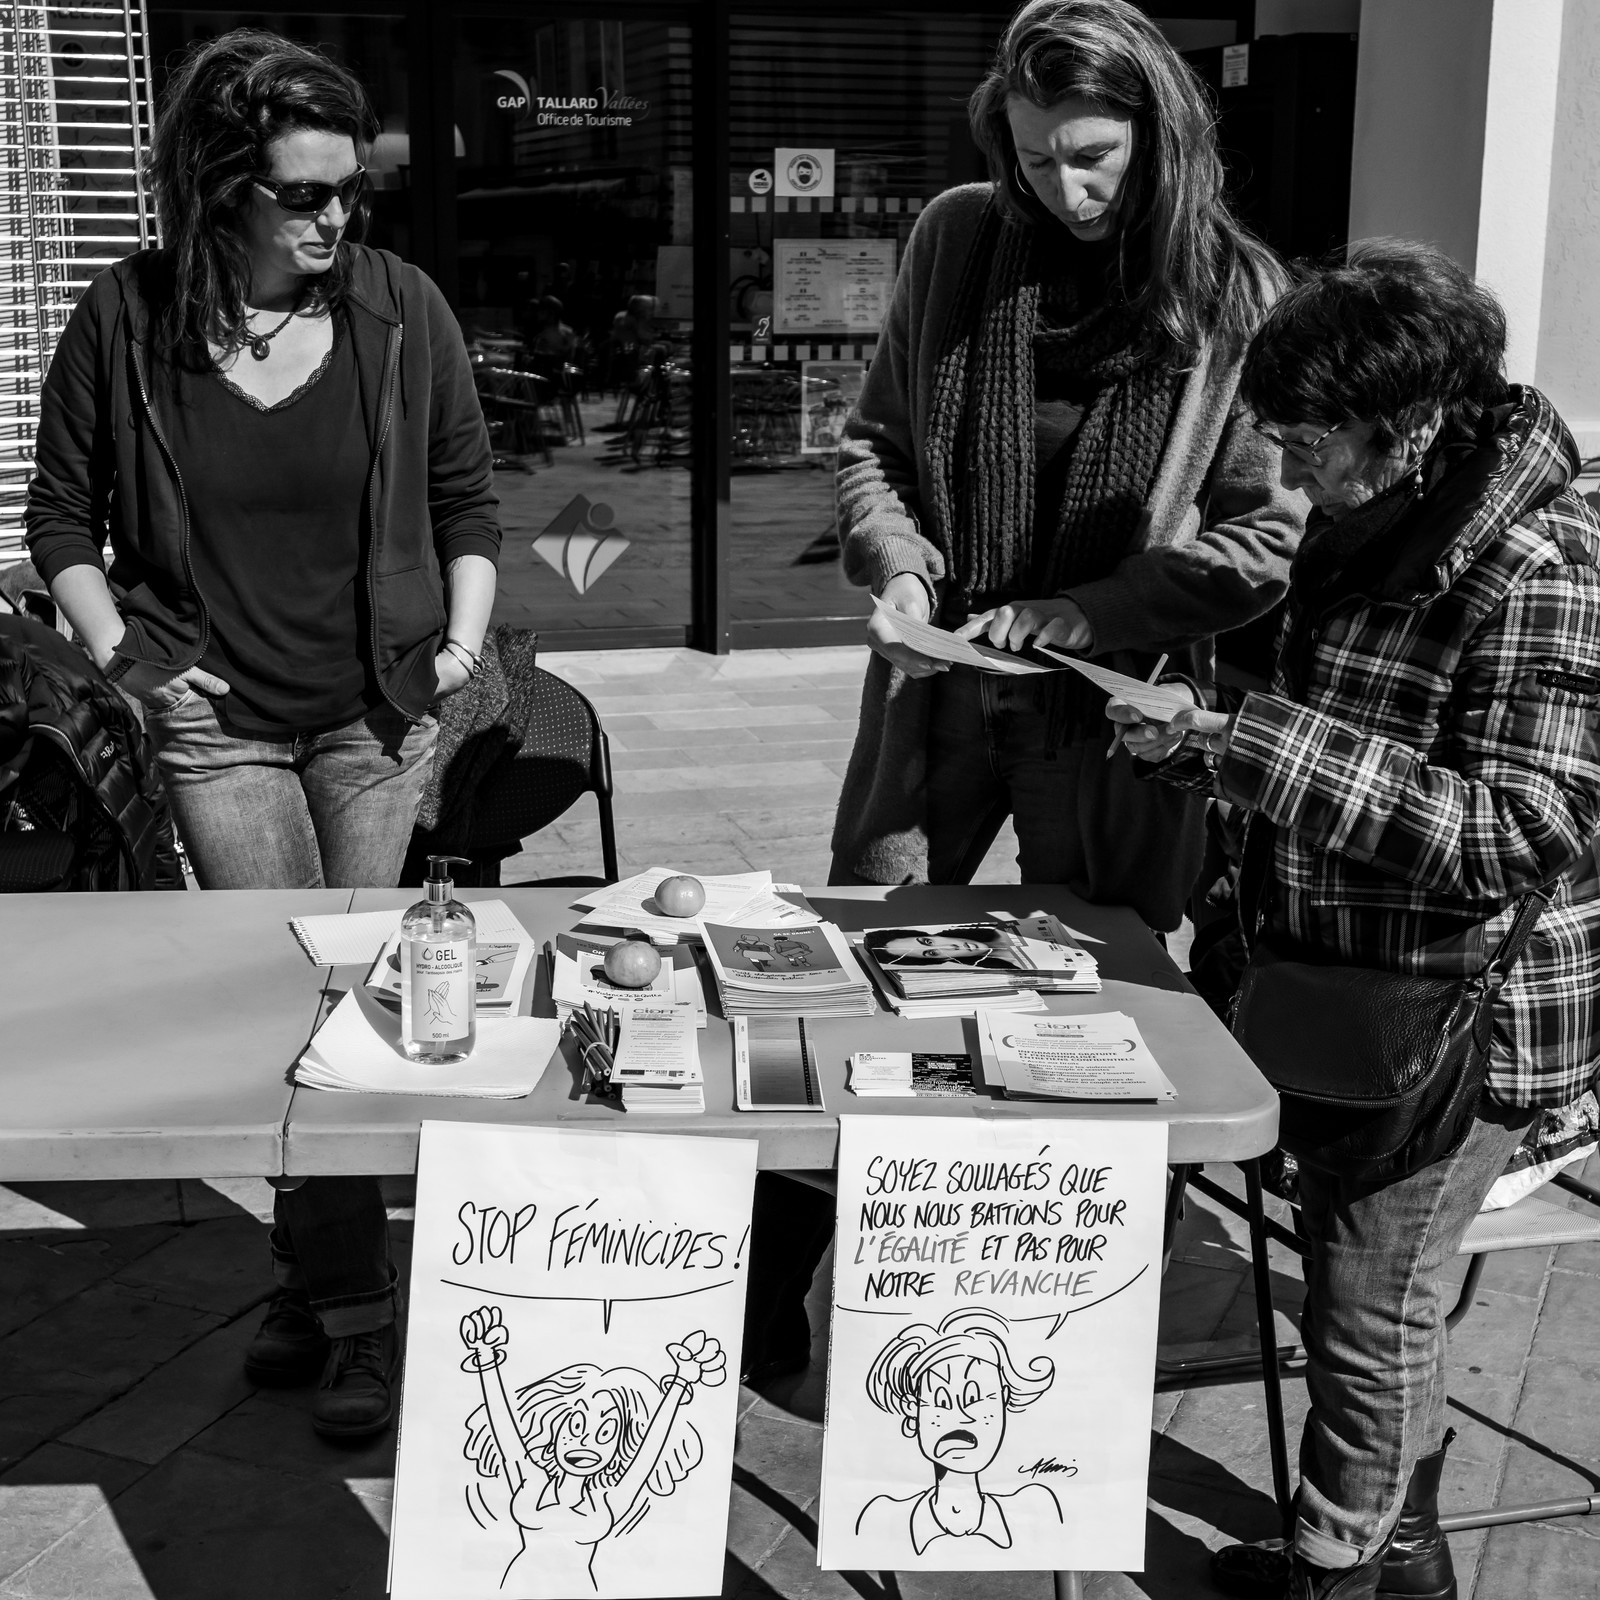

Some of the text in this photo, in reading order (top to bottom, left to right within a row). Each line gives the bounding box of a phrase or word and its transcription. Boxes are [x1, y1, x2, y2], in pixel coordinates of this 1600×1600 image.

[497, 86, 649, 110] GAP TALLARD Vallées
[537, 112, 633, 127] Office de Tourisme
[434, 962, 463, 970] ALCOOLIQUE
[436, 949, 457, 961] GEL
[866, 1145, 1112, 1196] SOYEZ SOULAGÉS QUE
[859, 1199, 1127, 1232] NOUS NOUS BATTIONS POUR
[452, 1198, 750, 1271] STOP FÉMINICIDES !
[853, 1231, 1108, 1265] L'ÉGALITÉ ET PAS POUR
[864, 1268, 1098, 1302] NOTRE REVANCHE
